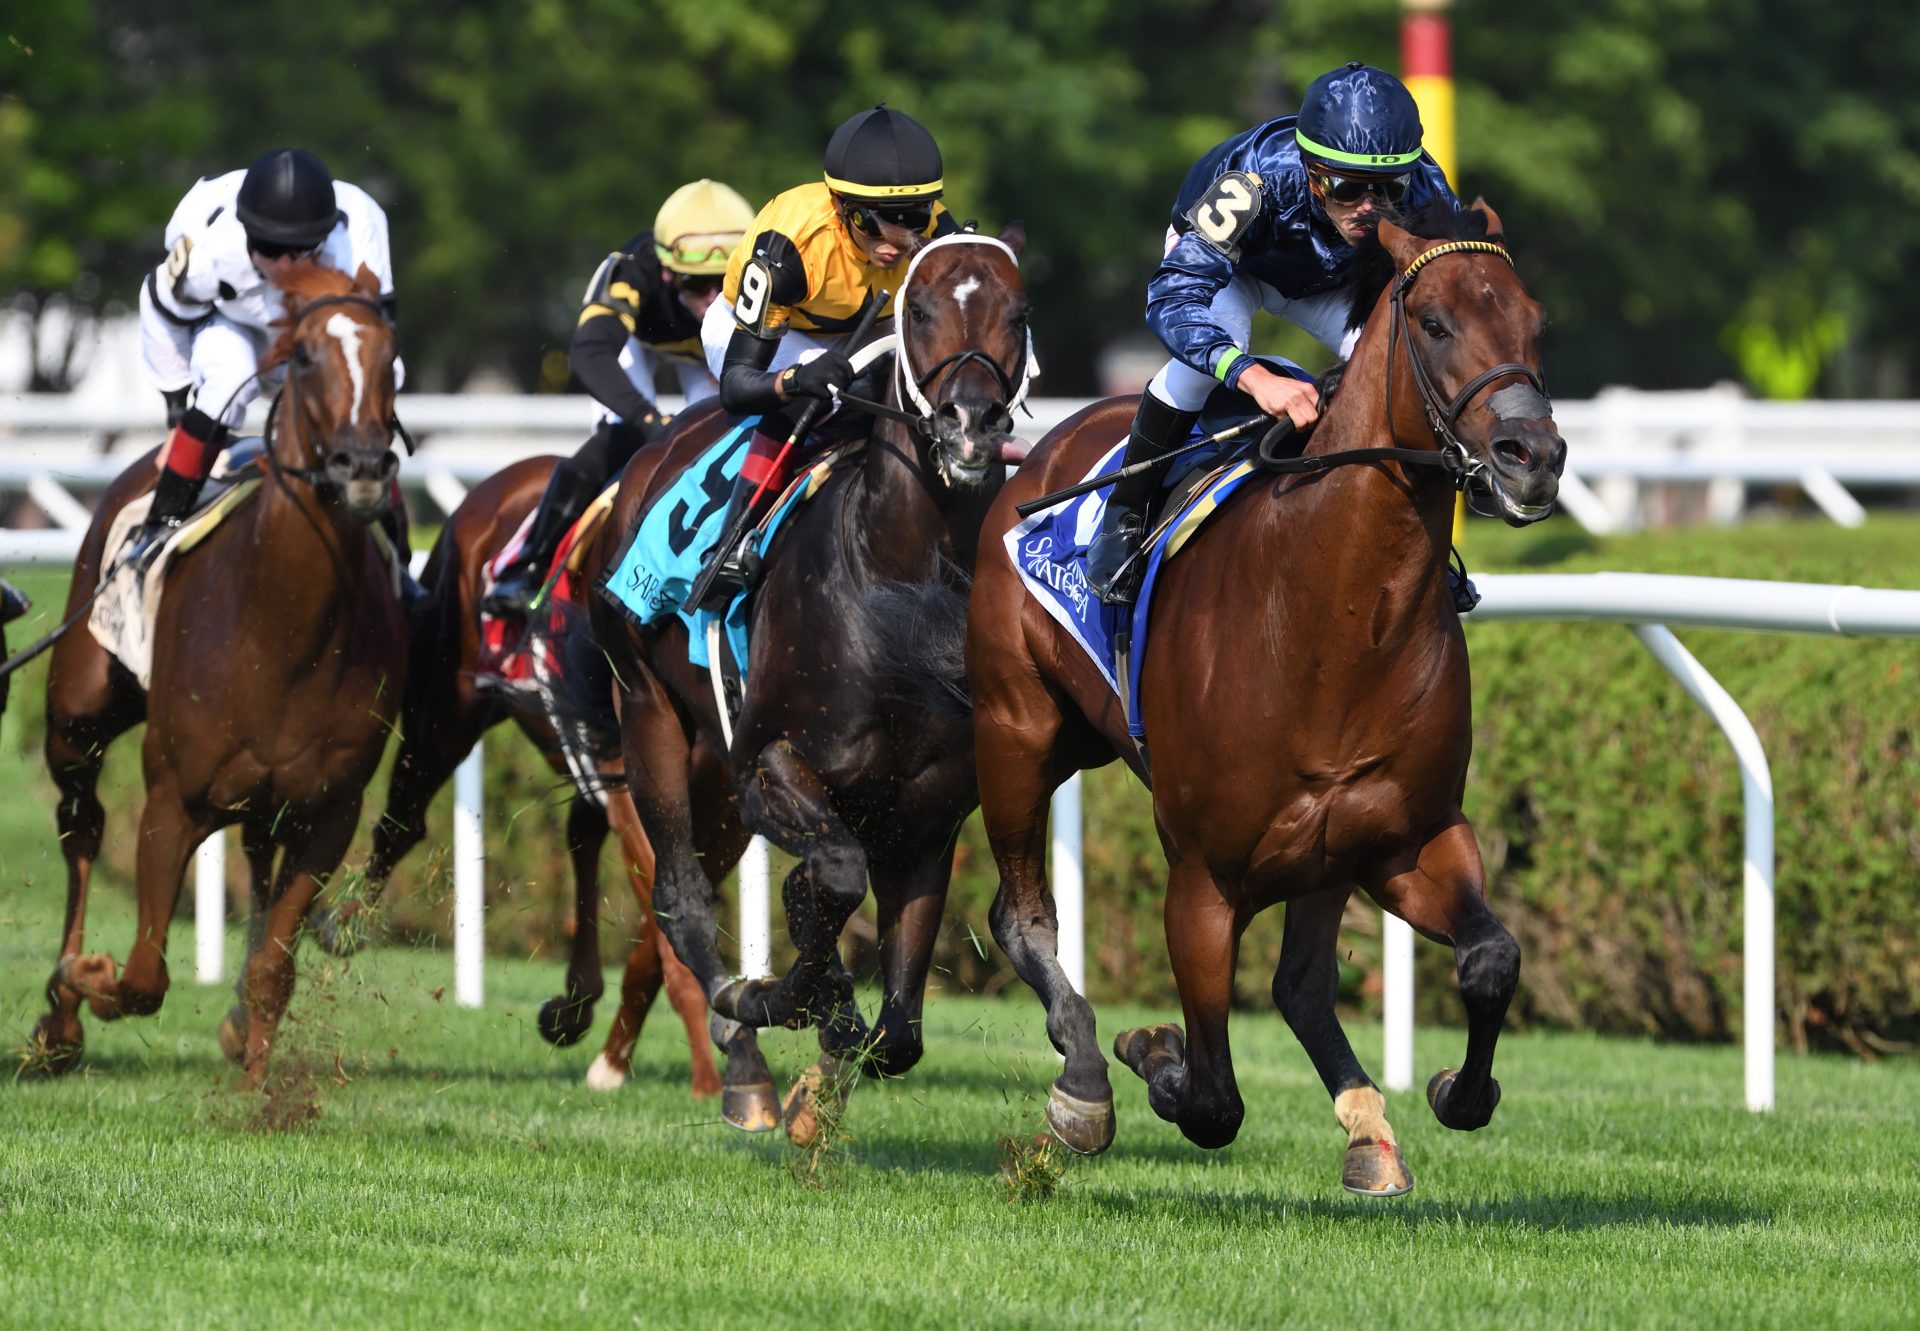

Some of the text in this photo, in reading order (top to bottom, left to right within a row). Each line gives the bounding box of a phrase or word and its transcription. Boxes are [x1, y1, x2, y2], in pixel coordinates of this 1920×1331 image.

[880, 186, 920, 194] JO
[1197, 178, 1251, 242] 3
[736, 261, 768, 325] 9
